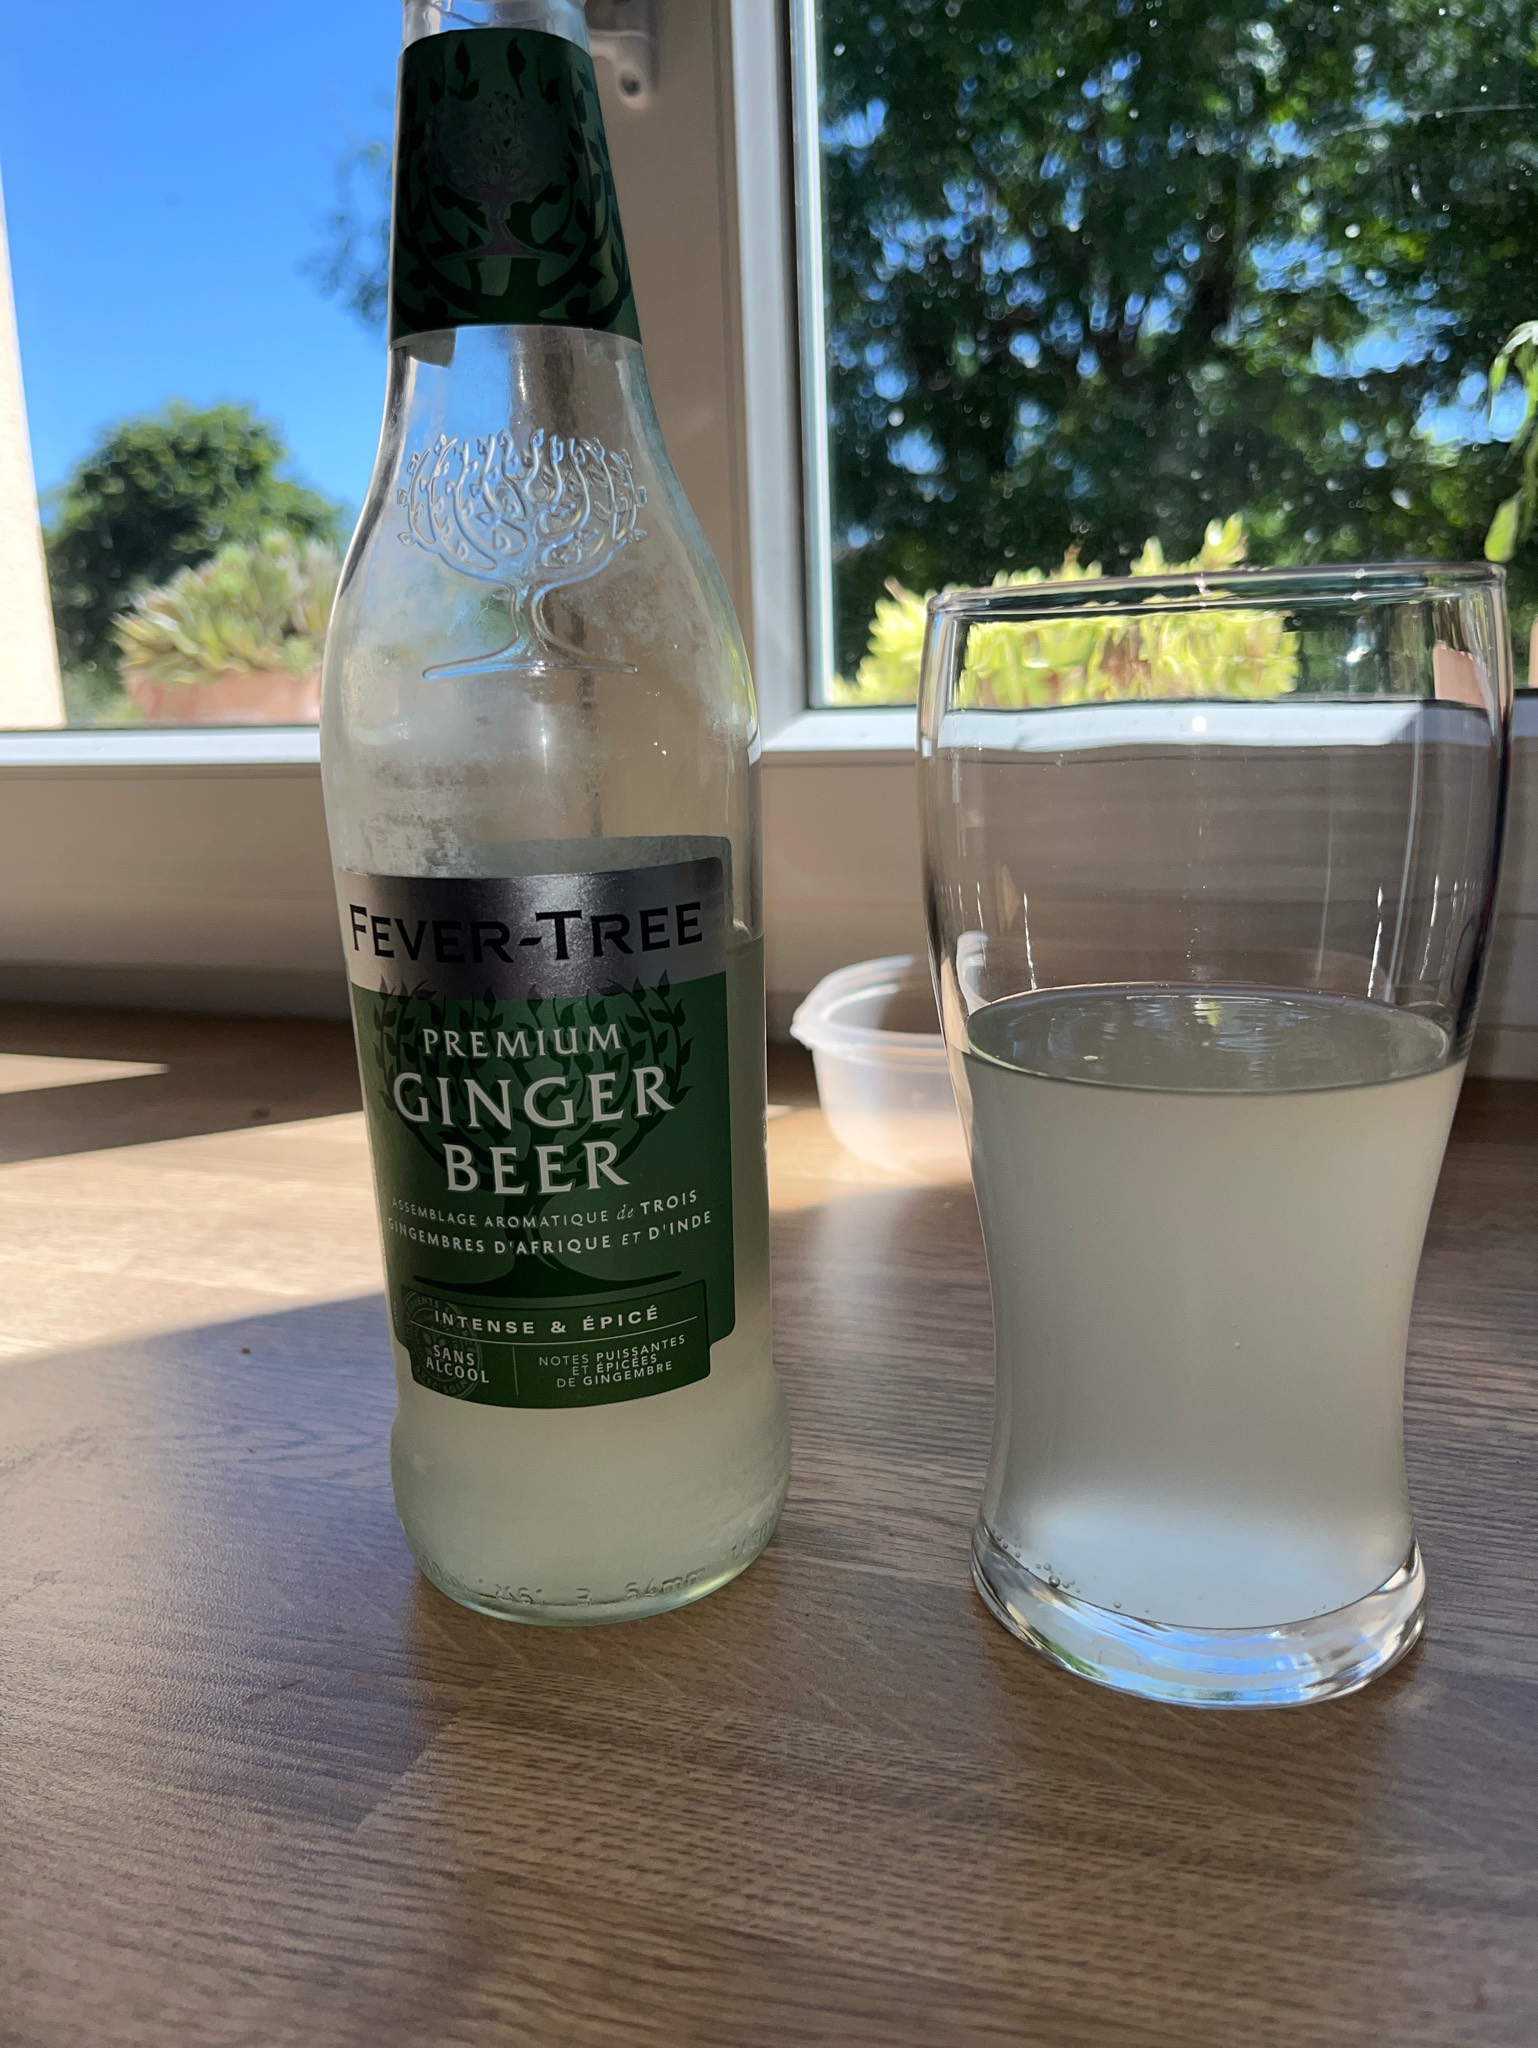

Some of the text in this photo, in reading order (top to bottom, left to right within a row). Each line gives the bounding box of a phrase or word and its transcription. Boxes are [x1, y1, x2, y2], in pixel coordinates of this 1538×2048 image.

[349, 902, 703, 964] FEVER-TREE
[423, 1023, 623, 1059] PREMIUM
[393, 1066, 676, 1130] GINGER
[443, 1141, 631, 1195] BEER
[392, 1190, 698, 1228] ASSEMBLAGE AROMATIQUE de TROIS
[388, 1211, 712, 1255] GINGEMBRES D'AFRIQUE ET D'INDE
[435, 1304, 659, 1334] INTENSE & ÉPICÉ
[433, 1344, 476, 1364] SANS
[539, 1334, 686, 1366] NOTES PUISSANTES
[572, 1352, 658, 1376] ET ÉPICÉES
[426, 1356, 490, 1384] ALCOOL
[557, 1360, 674, 1388] DE GINGEMBRE
